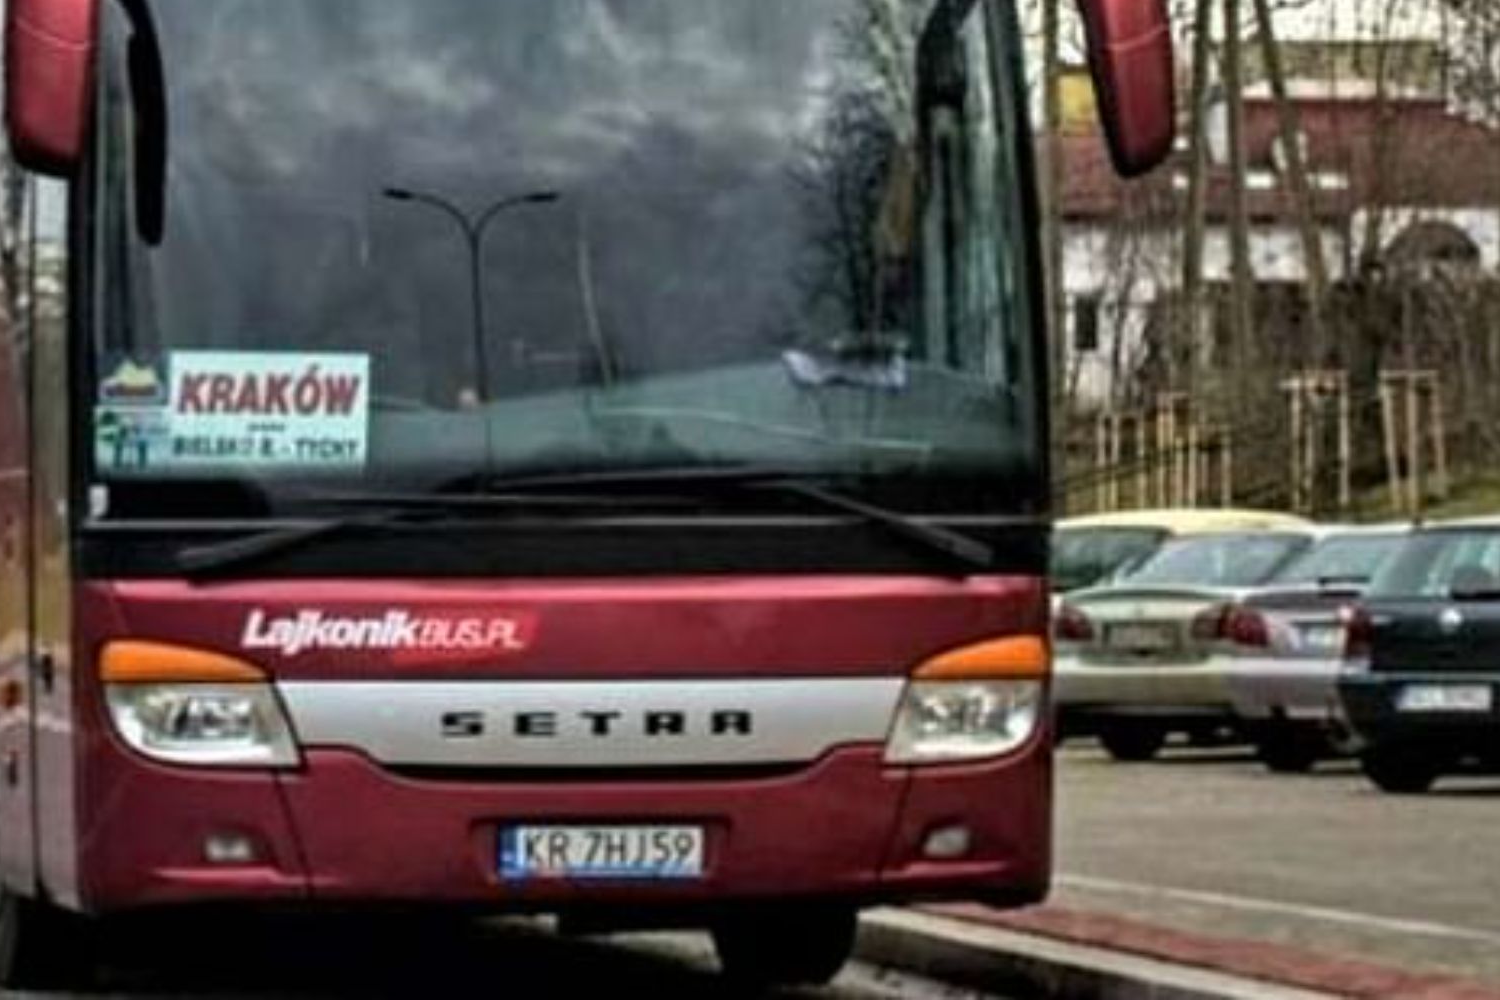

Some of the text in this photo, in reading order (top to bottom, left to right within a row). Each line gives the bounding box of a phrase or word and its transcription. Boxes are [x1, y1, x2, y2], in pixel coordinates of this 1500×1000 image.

[177, 363, 361, 415] KRAKÓW
[439, 708, 754, 738] SETRA
[524, 832, 694, 868] KR 7HJ59
